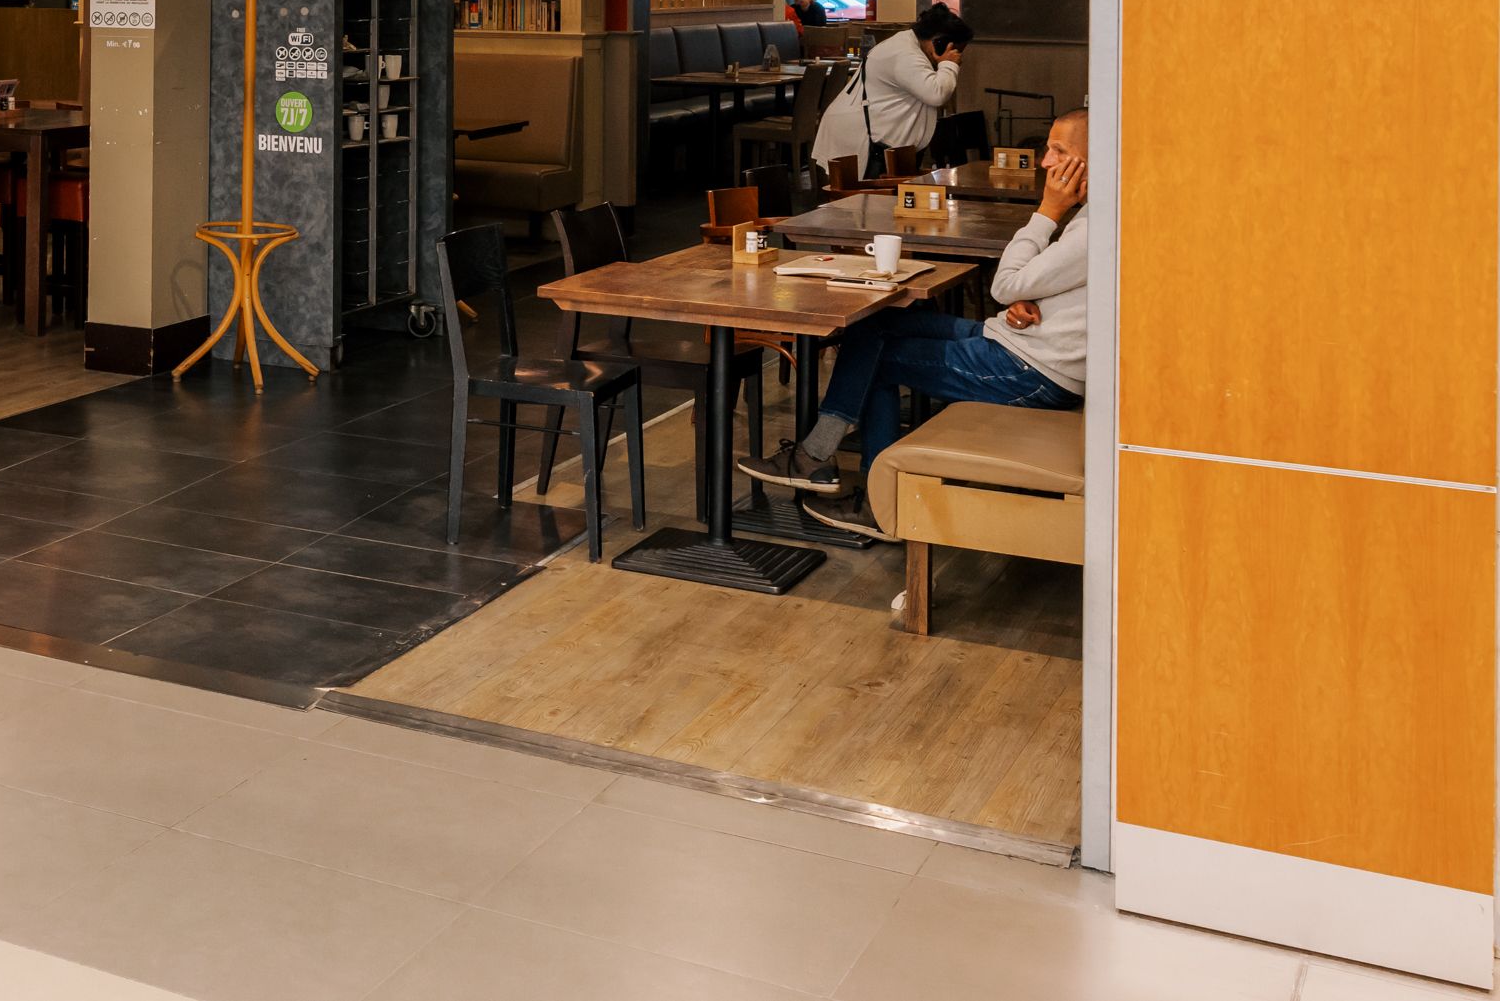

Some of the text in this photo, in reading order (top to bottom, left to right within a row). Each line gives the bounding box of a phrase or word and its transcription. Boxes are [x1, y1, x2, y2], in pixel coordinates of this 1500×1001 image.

[280, 98, 308, 108] OUVERT
[280, 107, 308, 127] 7J/7
[258, 134, 323, 154] BIENVENU
